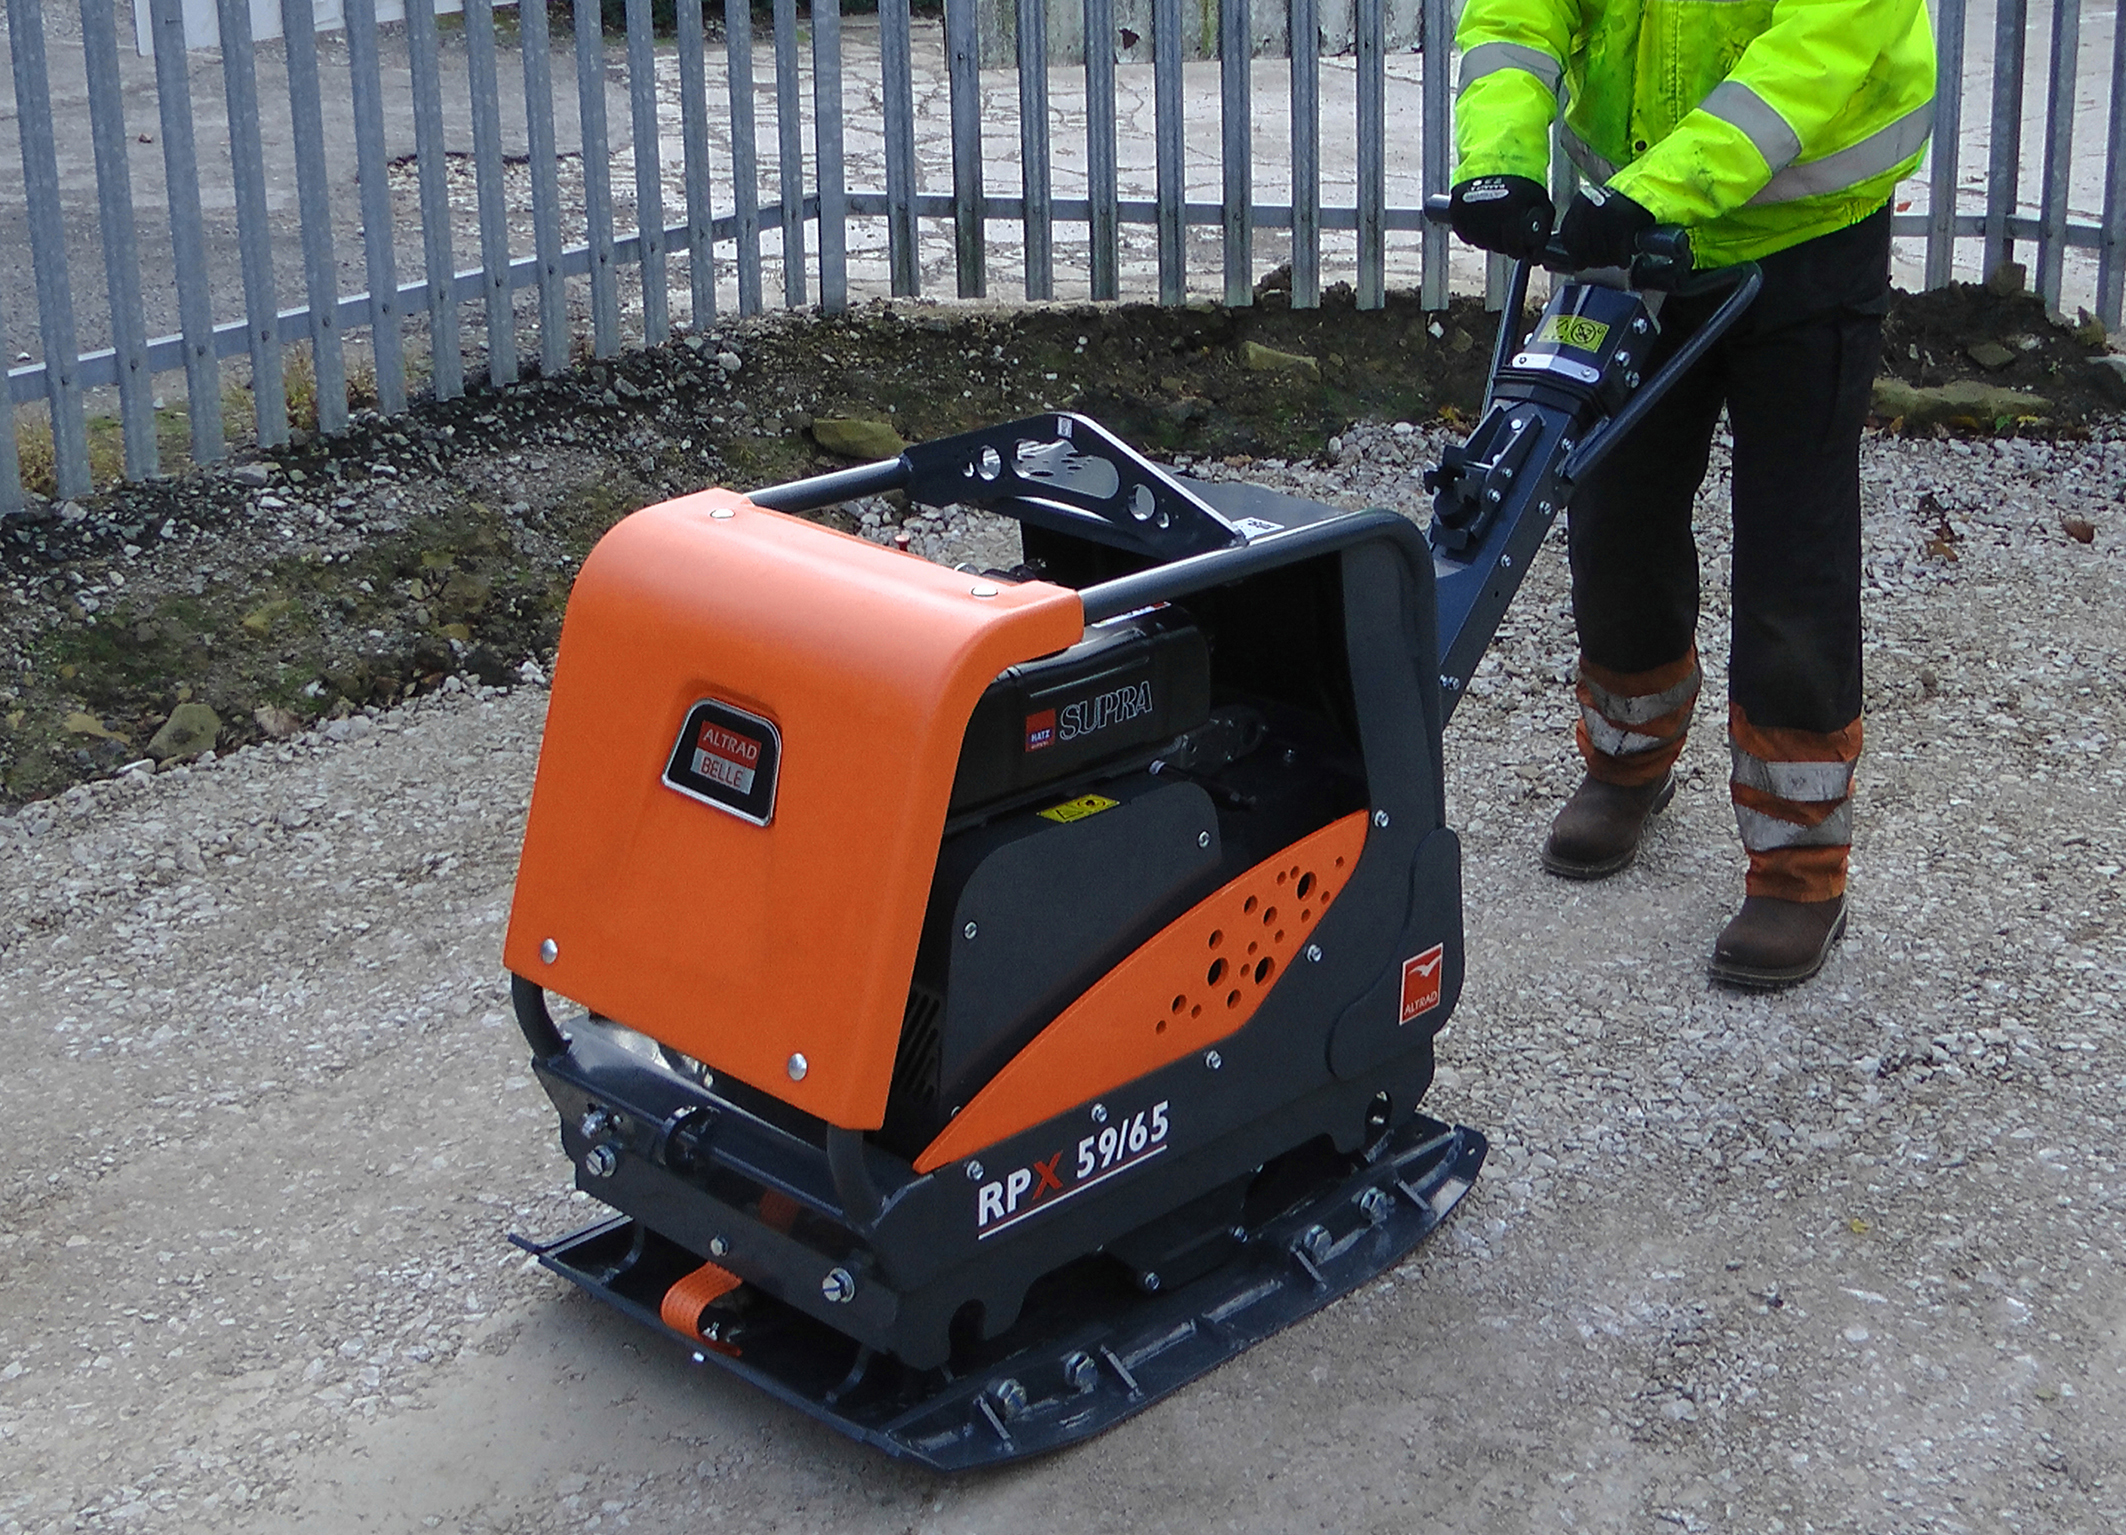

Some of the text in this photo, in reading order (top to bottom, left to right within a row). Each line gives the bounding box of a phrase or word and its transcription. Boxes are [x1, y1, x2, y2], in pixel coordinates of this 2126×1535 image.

[1059, 680, 1153, 740] SUPRA
[703, 728, 757, 760] ALTRAD
[700, 756, 744, 788] BELLE
[1404, 990, 1438, 1016] ALTRAD
[978, 1100, 1169, 1227] RPX 59/65
